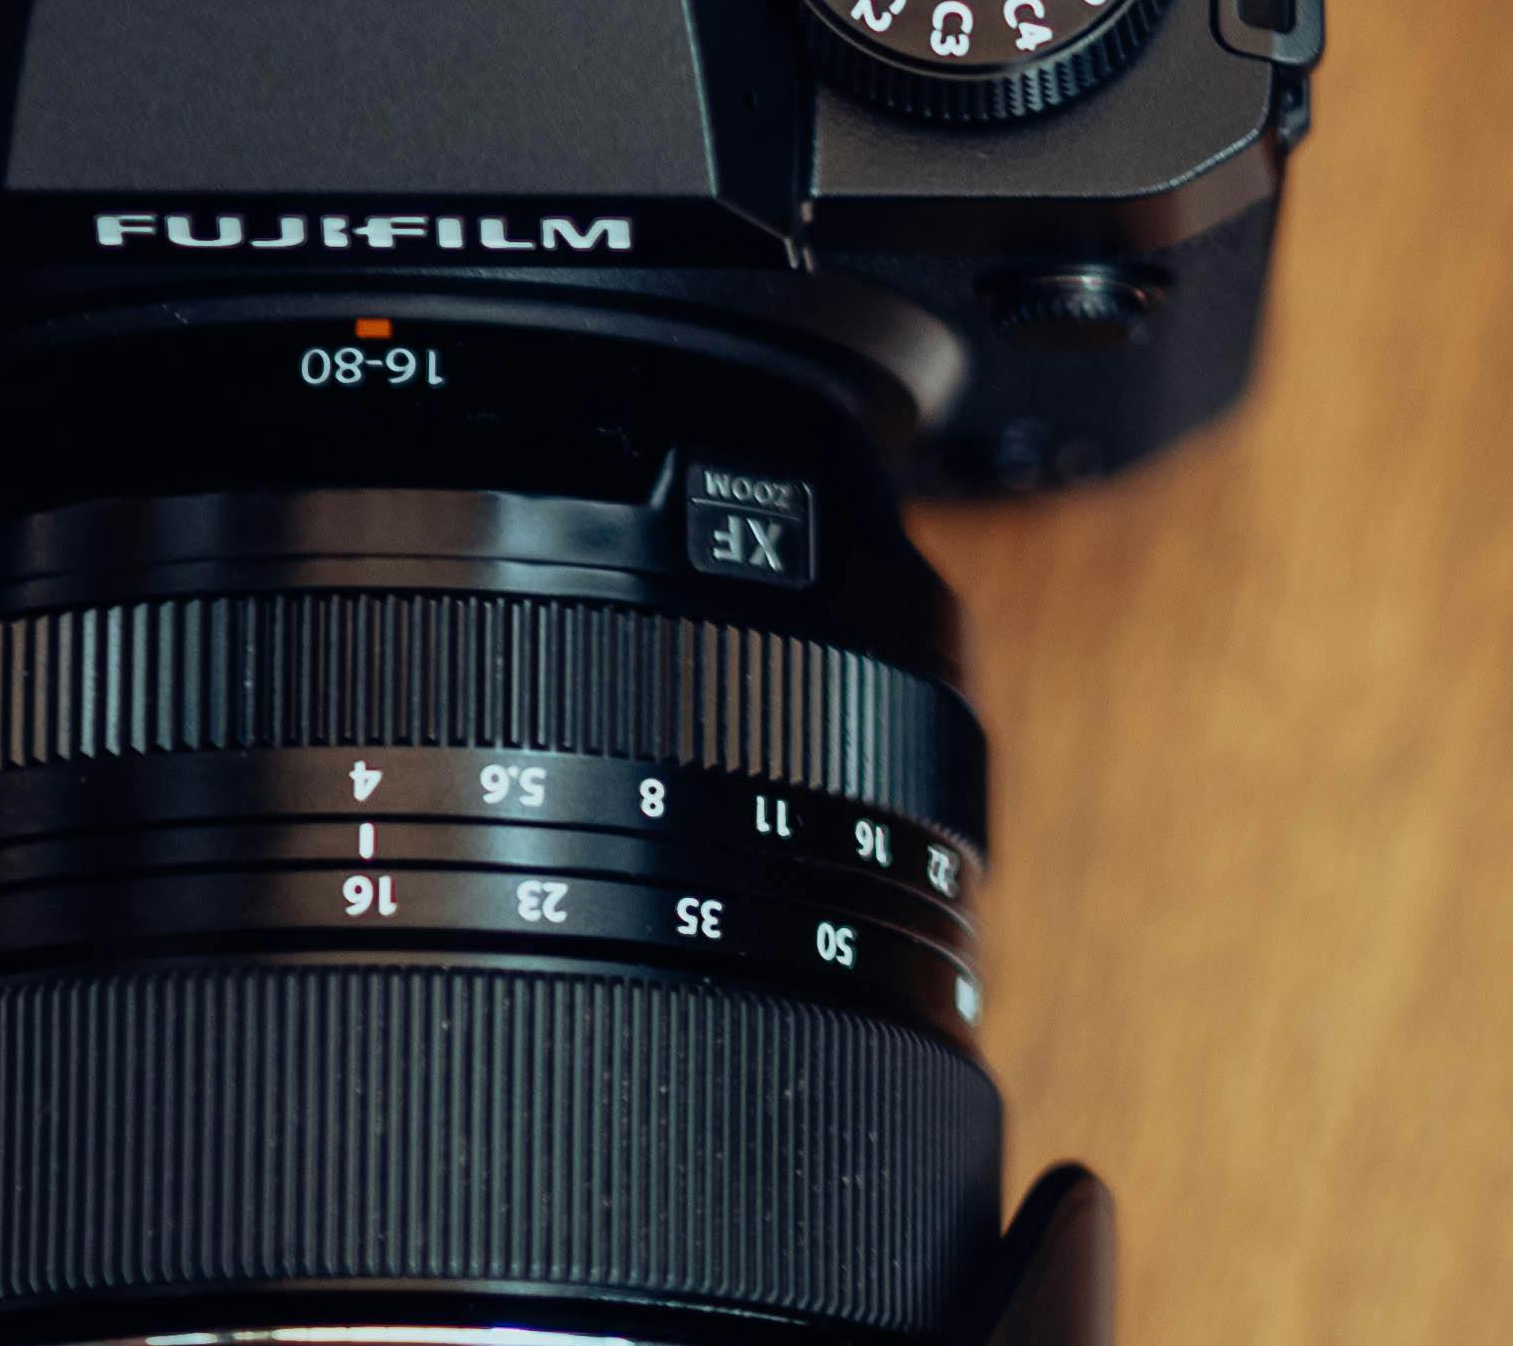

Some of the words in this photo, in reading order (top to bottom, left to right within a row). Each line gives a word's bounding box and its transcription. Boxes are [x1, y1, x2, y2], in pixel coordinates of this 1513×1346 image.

[929, 0, 974, 57] C3
[93, 212, 633, 251] FUJIFILM
[299, 346, 446, 386] 16-80
[703, 469, 794, 511] ZOOM
[712, 514, 784, 572] XF
[348, 760, 383, 801] 4
[479, 763, 547, 808] 5.6
[637, 777, 667, 819] 8
[753, 793, 792, 838] 11
[852, 818, 892, 867] 16
[341, 874, 397, 916] 16
[516, 880, 569, 923] 23
[675, 896, 723, 939] 35
[815, 921, 858, 968] 50
